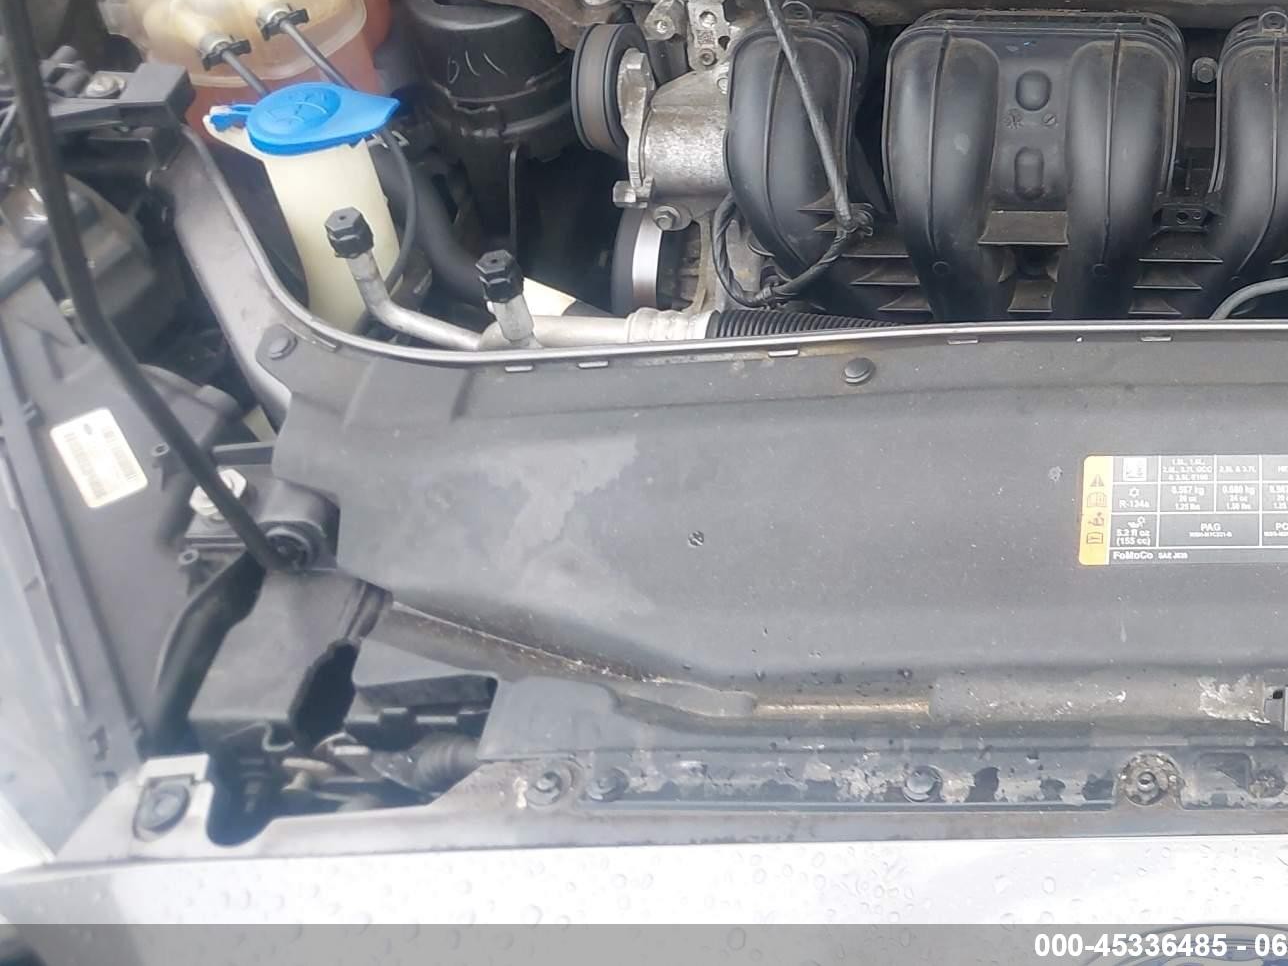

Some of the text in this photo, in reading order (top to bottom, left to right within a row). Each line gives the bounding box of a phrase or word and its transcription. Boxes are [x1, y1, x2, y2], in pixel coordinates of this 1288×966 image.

[1200, 522, 1221, 531] PAG
[1116, 537, 1151, 546] (155 cc)
[1113, 550, 1154, 560] FoMoCo
